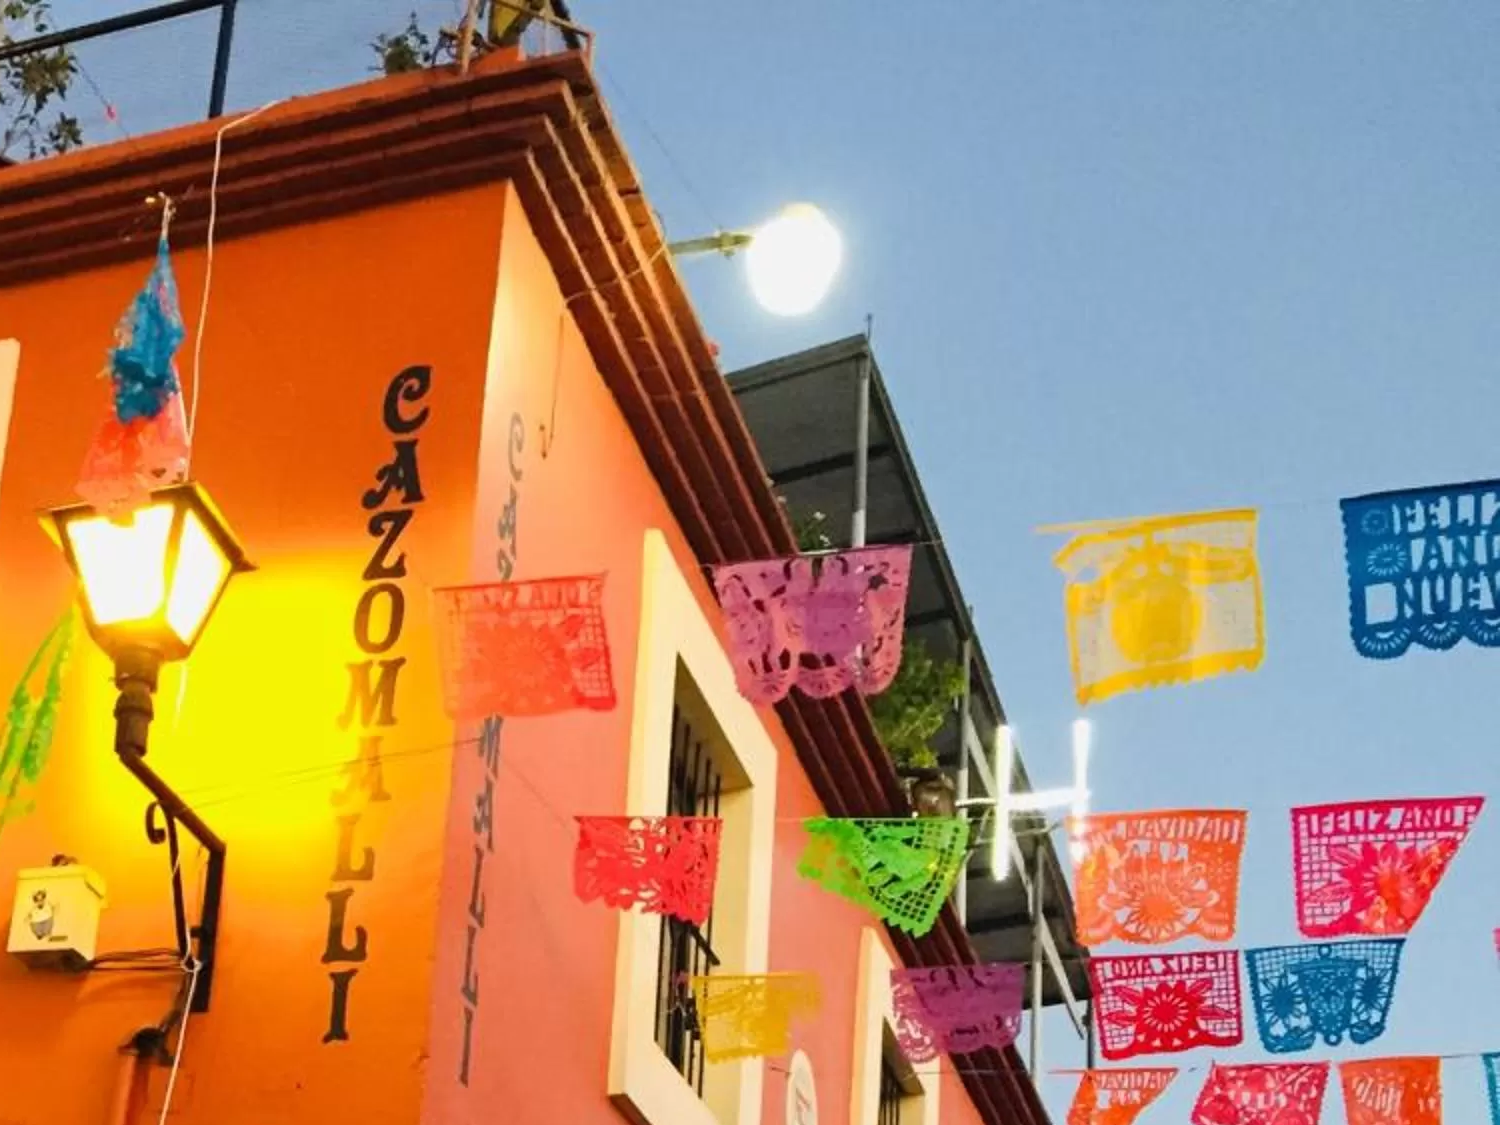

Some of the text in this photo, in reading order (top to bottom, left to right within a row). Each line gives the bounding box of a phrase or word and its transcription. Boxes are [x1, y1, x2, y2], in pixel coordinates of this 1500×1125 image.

[322, 364, 433, 1044] CAZOMALLI
[459, 411, 526, 1087] CAZMALLI
[1399, 490, 1500, 532] FELI
